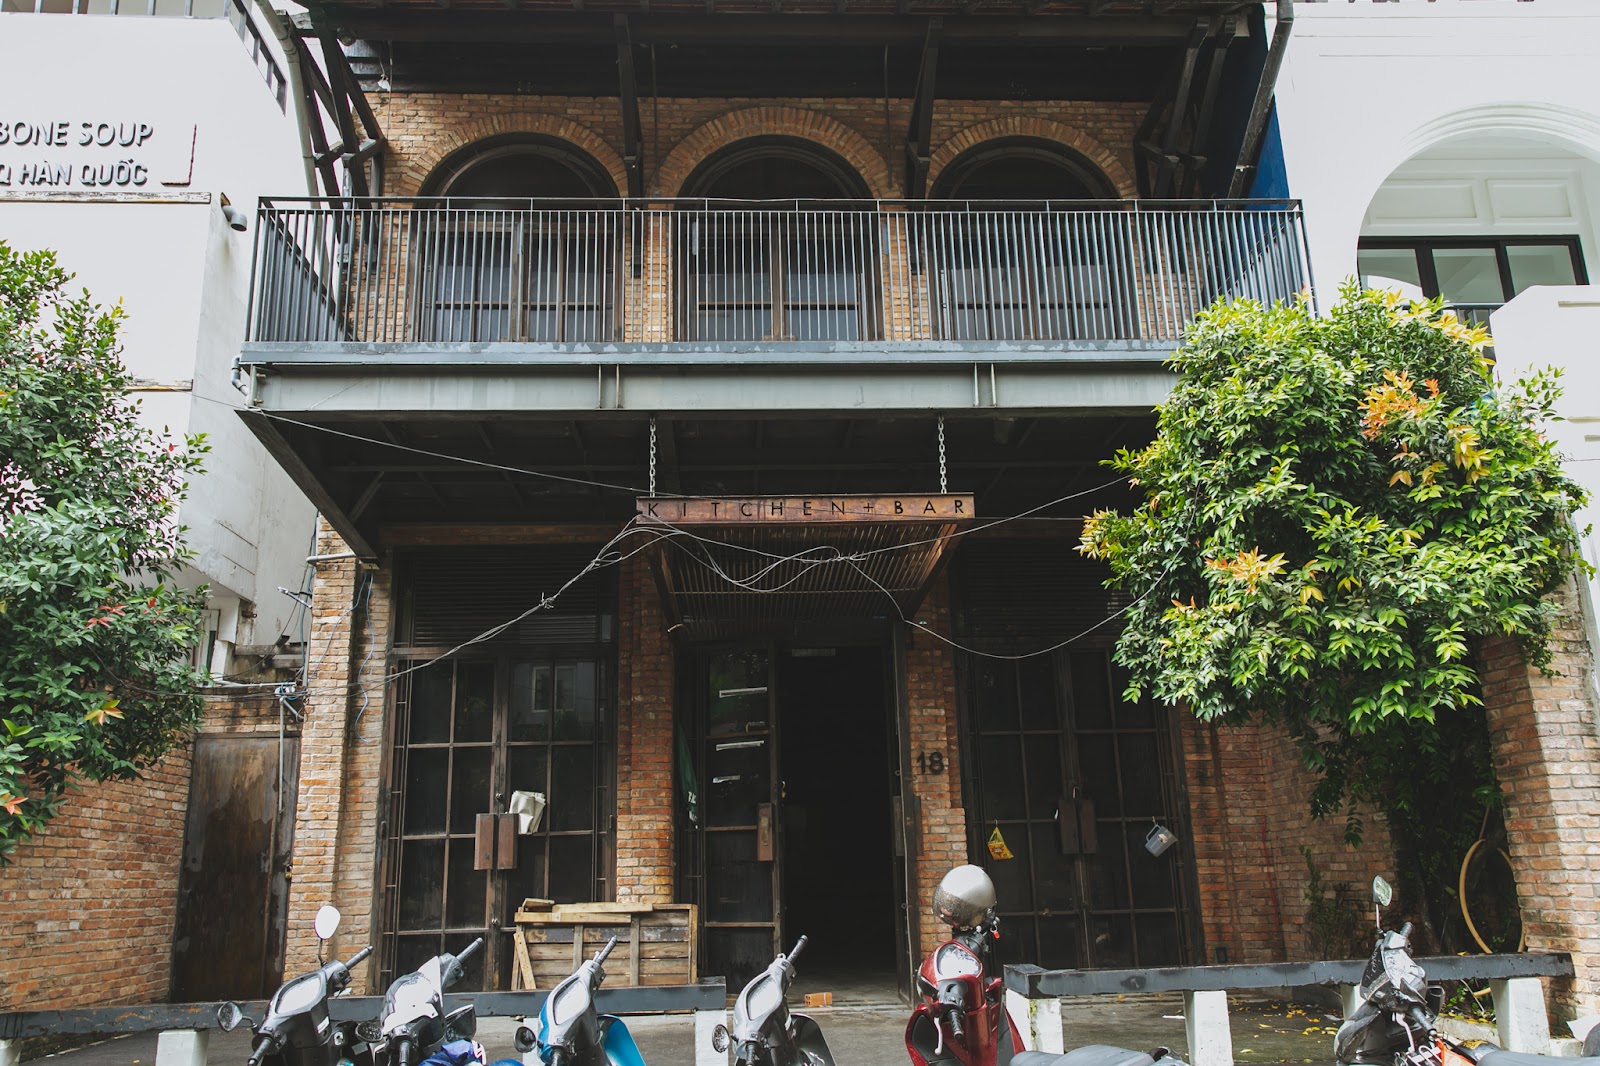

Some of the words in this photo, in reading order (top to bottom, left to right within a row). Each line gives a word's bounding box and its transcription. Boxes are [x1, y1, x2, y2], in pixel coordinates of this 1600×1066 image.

[0, 121, 70, 146] BONE
[78, 121, 153, 147] SOUP
[18, 160, 73, 187] HÀN
[79, 158, 148, 187] QUỐC
[917, 751, 945, 776] 18
